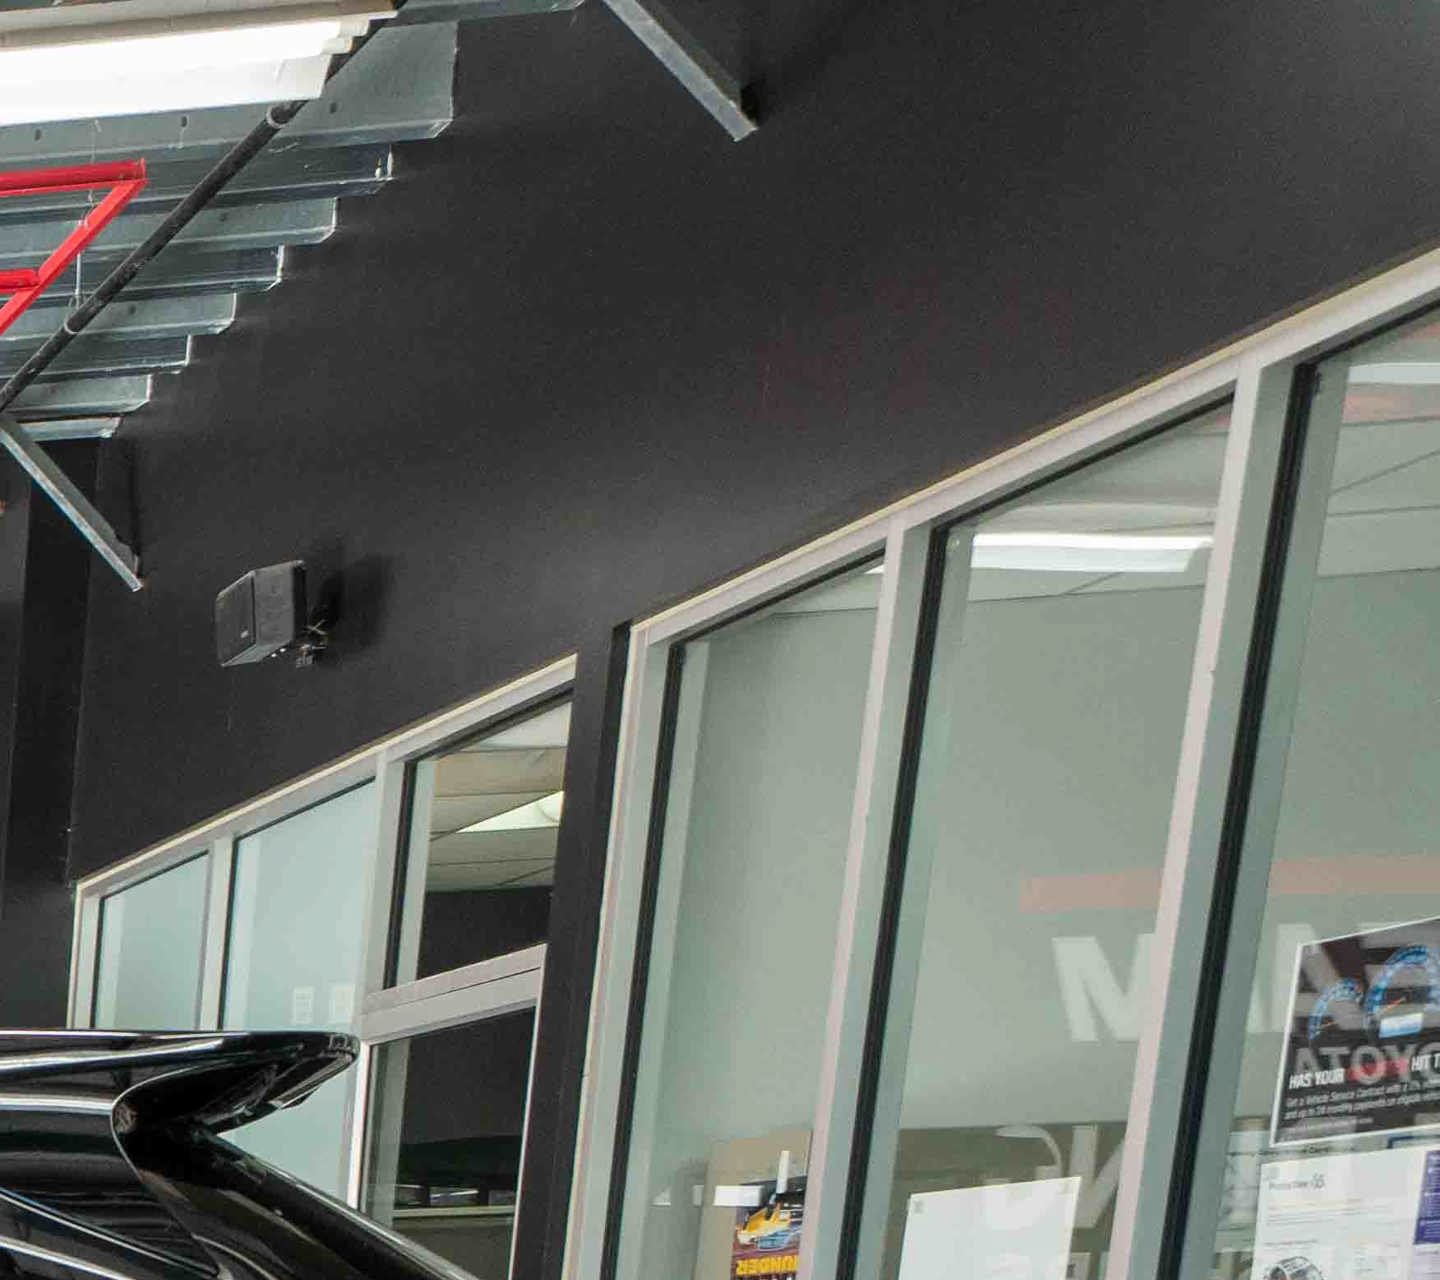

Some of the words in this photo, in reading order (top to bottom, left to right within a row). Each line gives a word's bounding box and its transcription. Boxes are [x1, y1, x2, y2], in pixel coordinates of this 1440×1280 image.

[1411, 1054, 1432, 1071] HIT
[1289, 1073, 1311, 1089] HAS
[1314, 1068, 1345, 1086] YOUR
